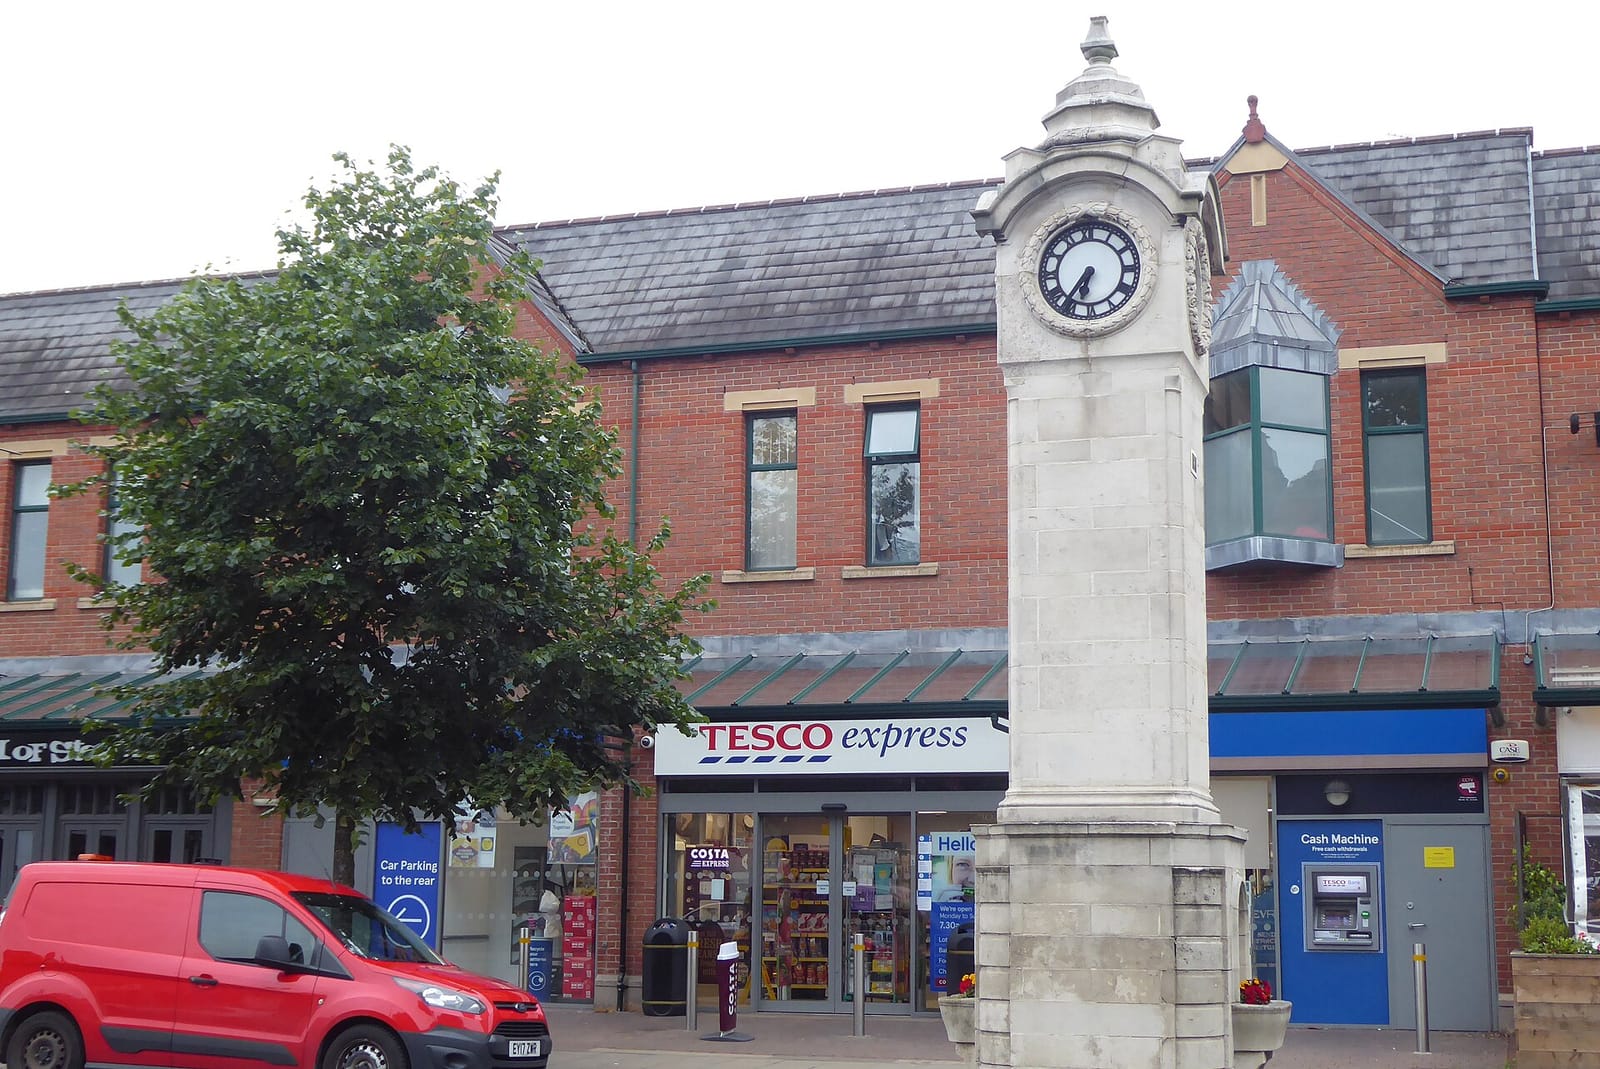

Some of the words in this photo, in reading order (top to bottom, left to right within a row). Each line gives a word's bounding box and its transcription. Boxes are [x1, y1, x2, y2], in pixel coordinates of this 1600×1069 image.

[698, 723, 833, 750] TESCO
[841, 723, 968, 757] express
[1301, 834, 1329, 845] Cash
[1331, 834, 1379, 845] Machine
[690, 849, 729, 860] COSTA
[380, 860, 399, 870] Car
[401, 860, 438, 873] Parking
[702, 860, 729, 868] EXPRESS
[381, 875, 393, 885] to
[395, 875, 412, 885] the
[414, 877, 436, 886] rear
[939, 912, 961, 920] Monday
[728, 963, 736, 1016] COSTA
